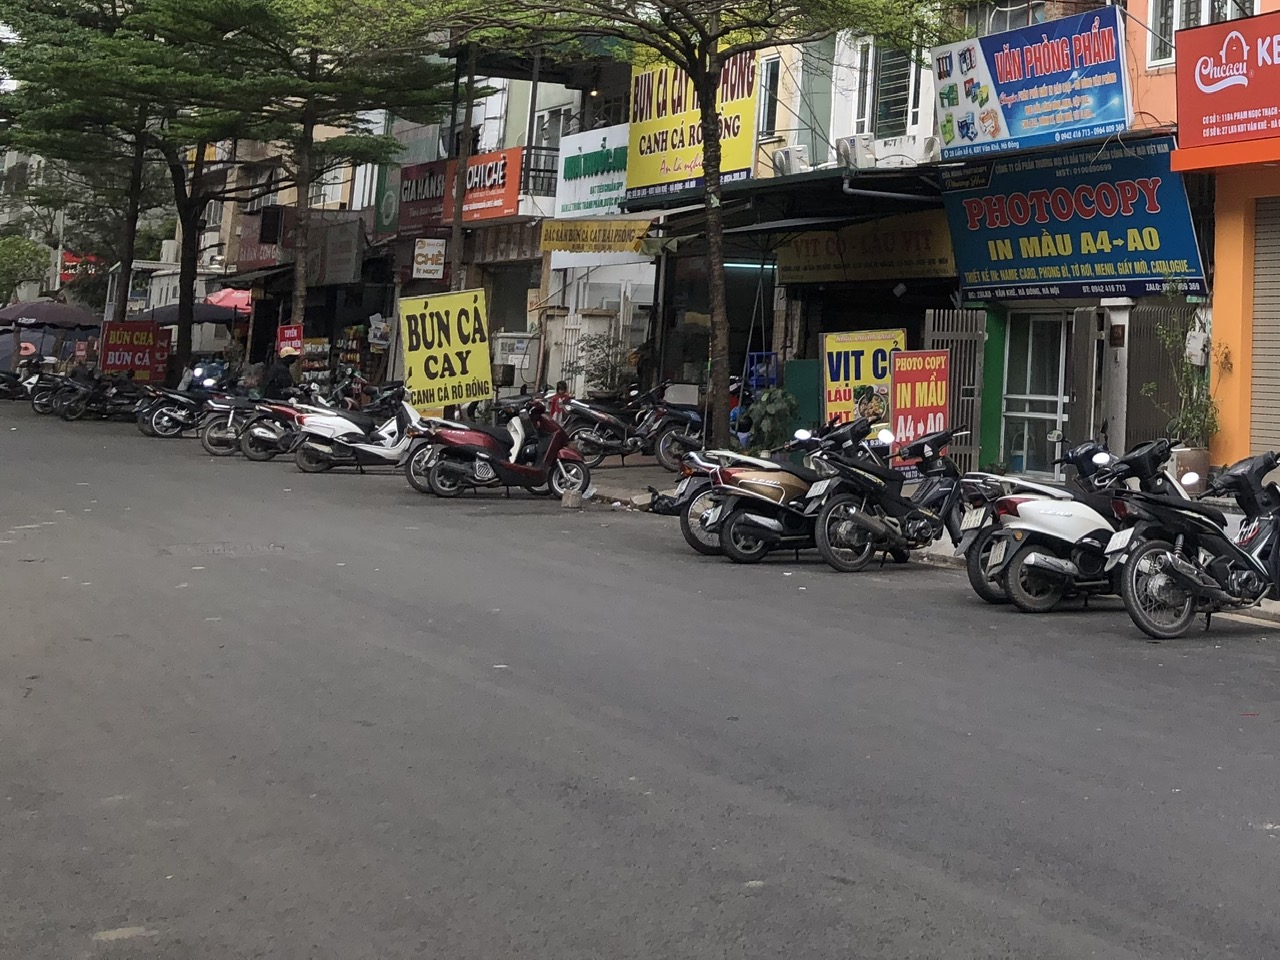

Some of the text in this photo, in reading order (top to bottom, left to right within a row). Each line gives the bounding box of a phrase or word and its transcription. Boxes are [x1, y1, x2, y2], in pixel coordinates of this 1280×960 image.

[994, 16, 1116, 84] VĂN PHÒNG PHẨM
[639, 120, 686, 156] CANH CÁ
[402, 179, 417, 202] GIA
[963, 176, 1162, 230] PHOTOCOPY
[988, 238, 1014, 262] IN
[1080, 229, 1112, 254] A4
[999, 268, 1018, 281] NAME
[1038, 265, 1060, 279] PHONG
[1094, 262, 1116, 277] MENU,
[108, 327, 132, 345] BÚN
[406, 294, 487, 352] BÚN CÁ
[106, 348, 133, 365] BÚN
[134, 349, 151, 366] CÁ
[424, 349, 472, 380] CAY
[826, 349, 865, 388] VỊT
[895, 355, 947, 371] PHOTO COPY
[410, 376, 490, 406] CANH CÁ RÔ ĐỒNG
[896, 382, 912, 409] IN
[895, 414, 914, 442] A4
